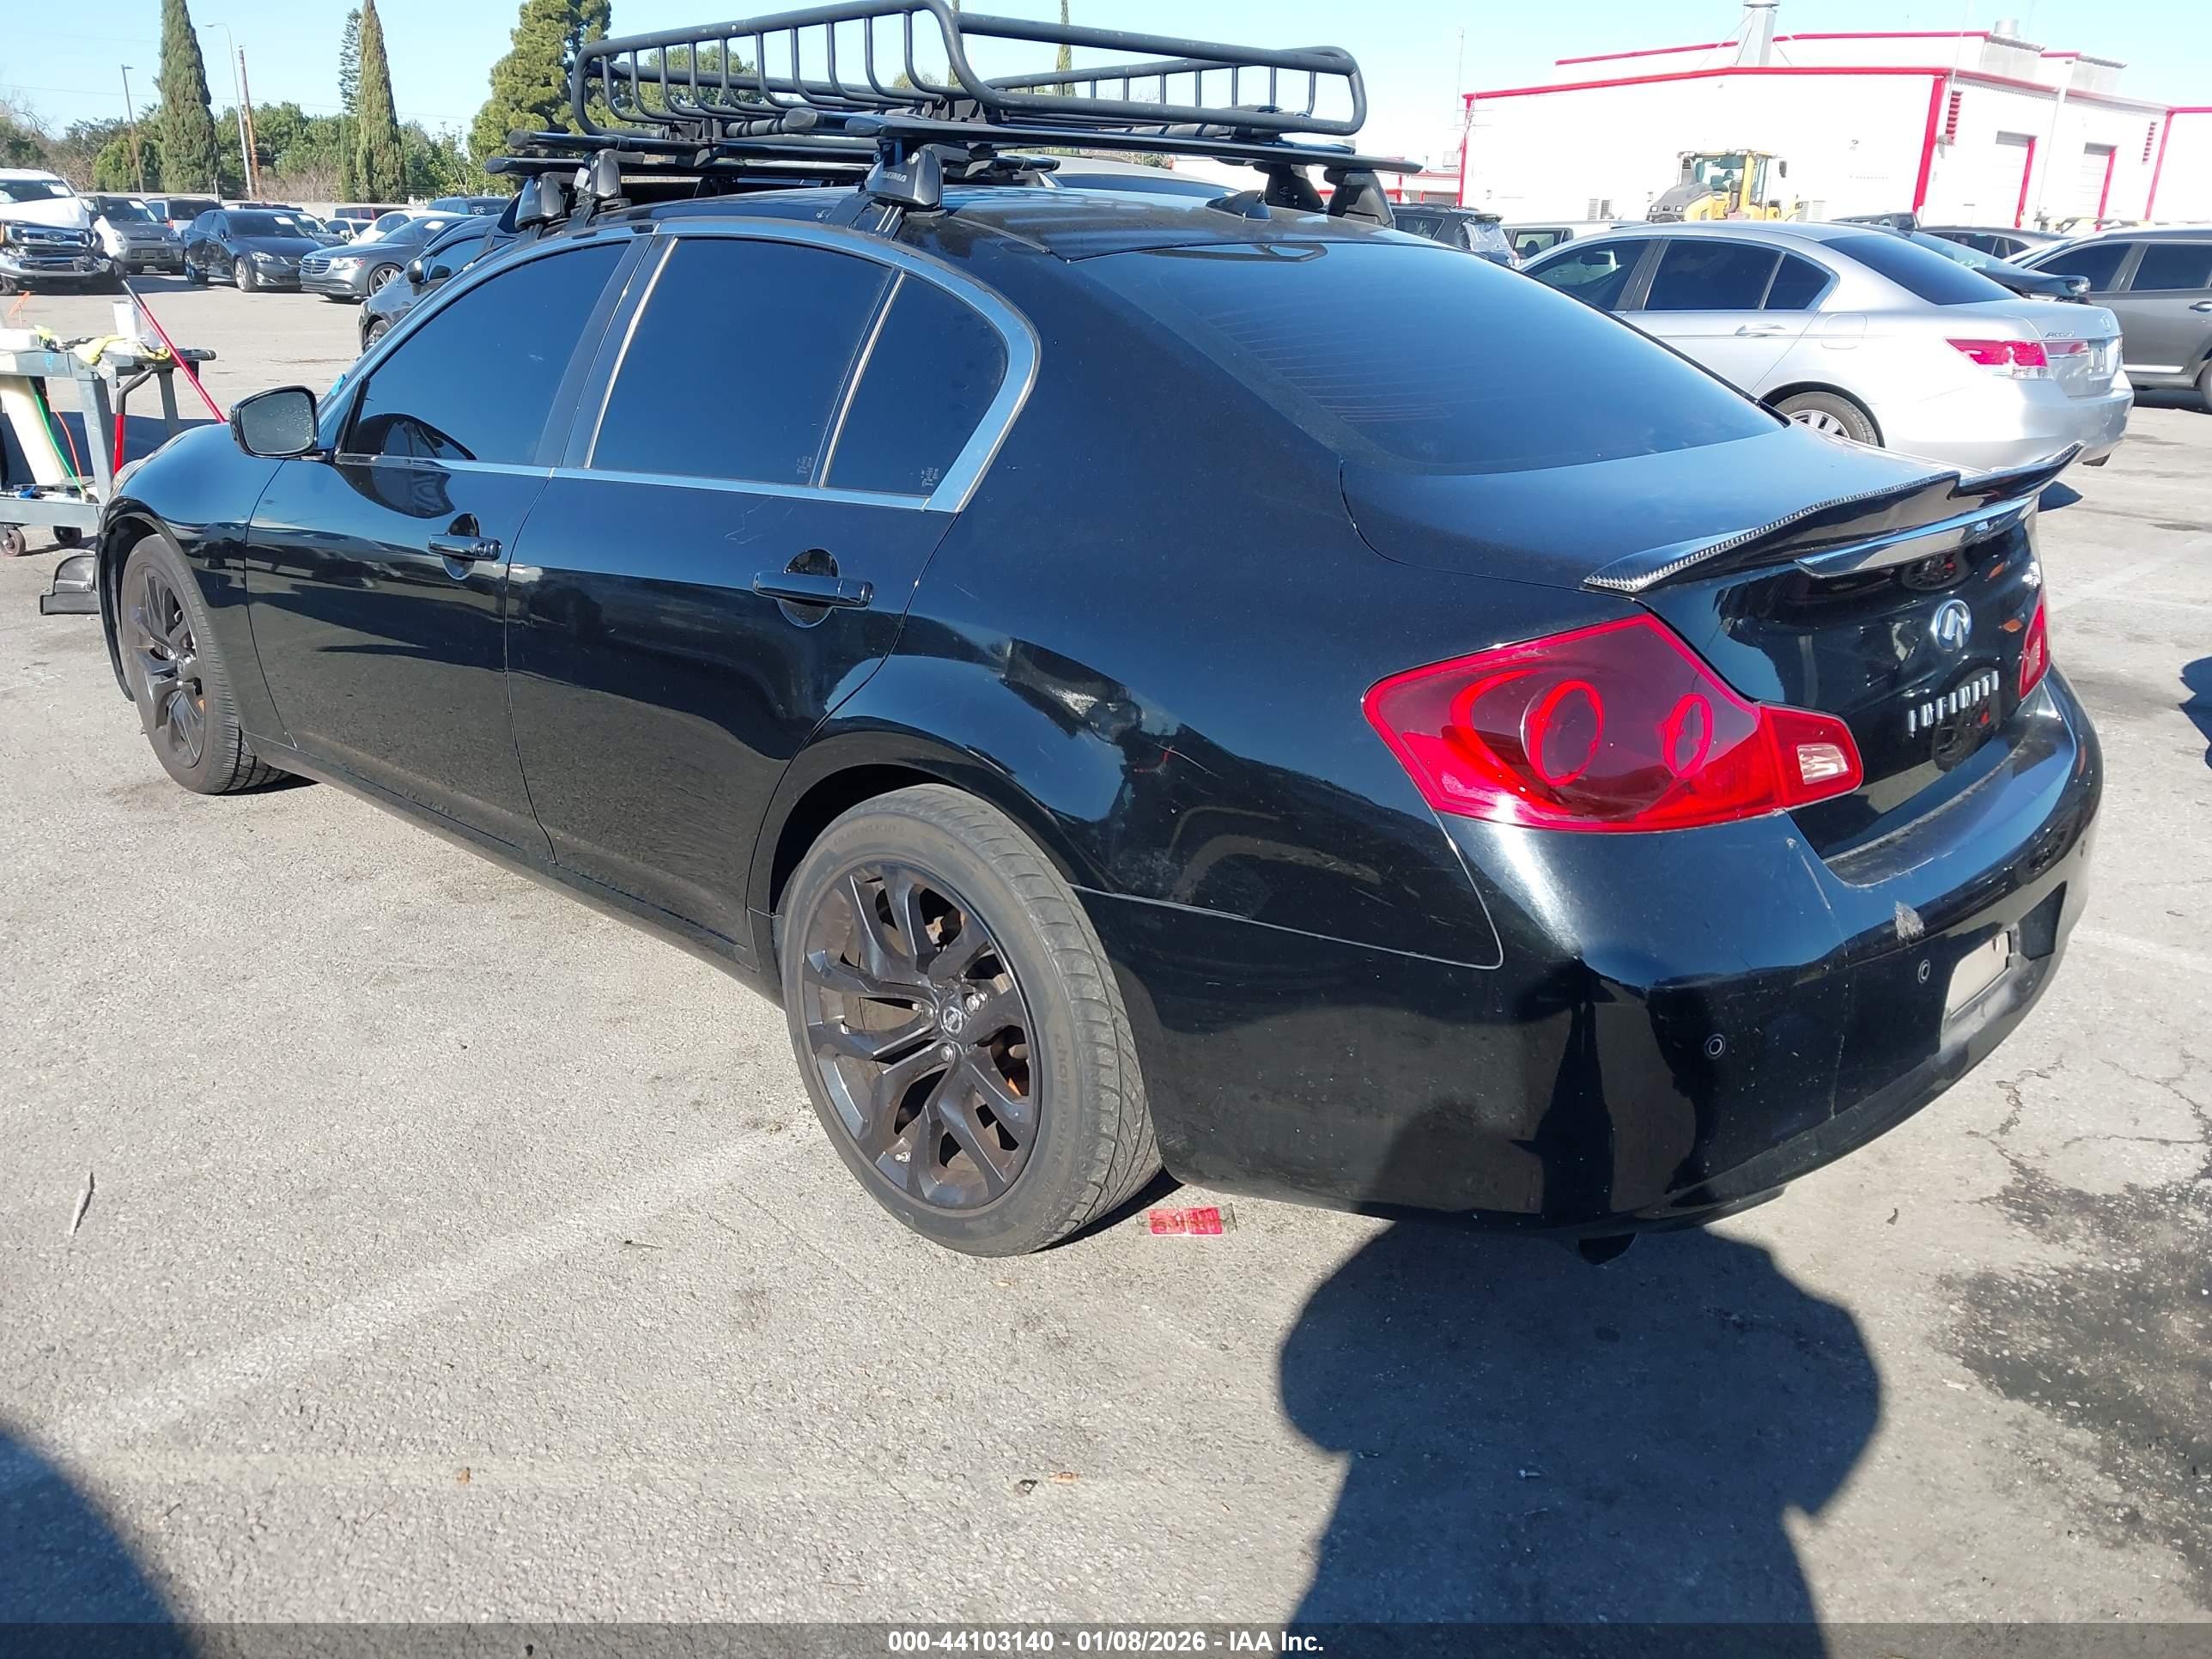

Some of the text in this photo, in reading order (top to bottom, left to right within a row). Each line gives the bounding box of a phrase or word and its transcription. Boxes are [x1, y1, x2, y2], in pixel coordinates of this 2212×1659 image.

[879, 171, 908, 183] KIMA
[2045, 330, 2075, 338] Accord
[1907, 670, 2000, 732] INFINITI
